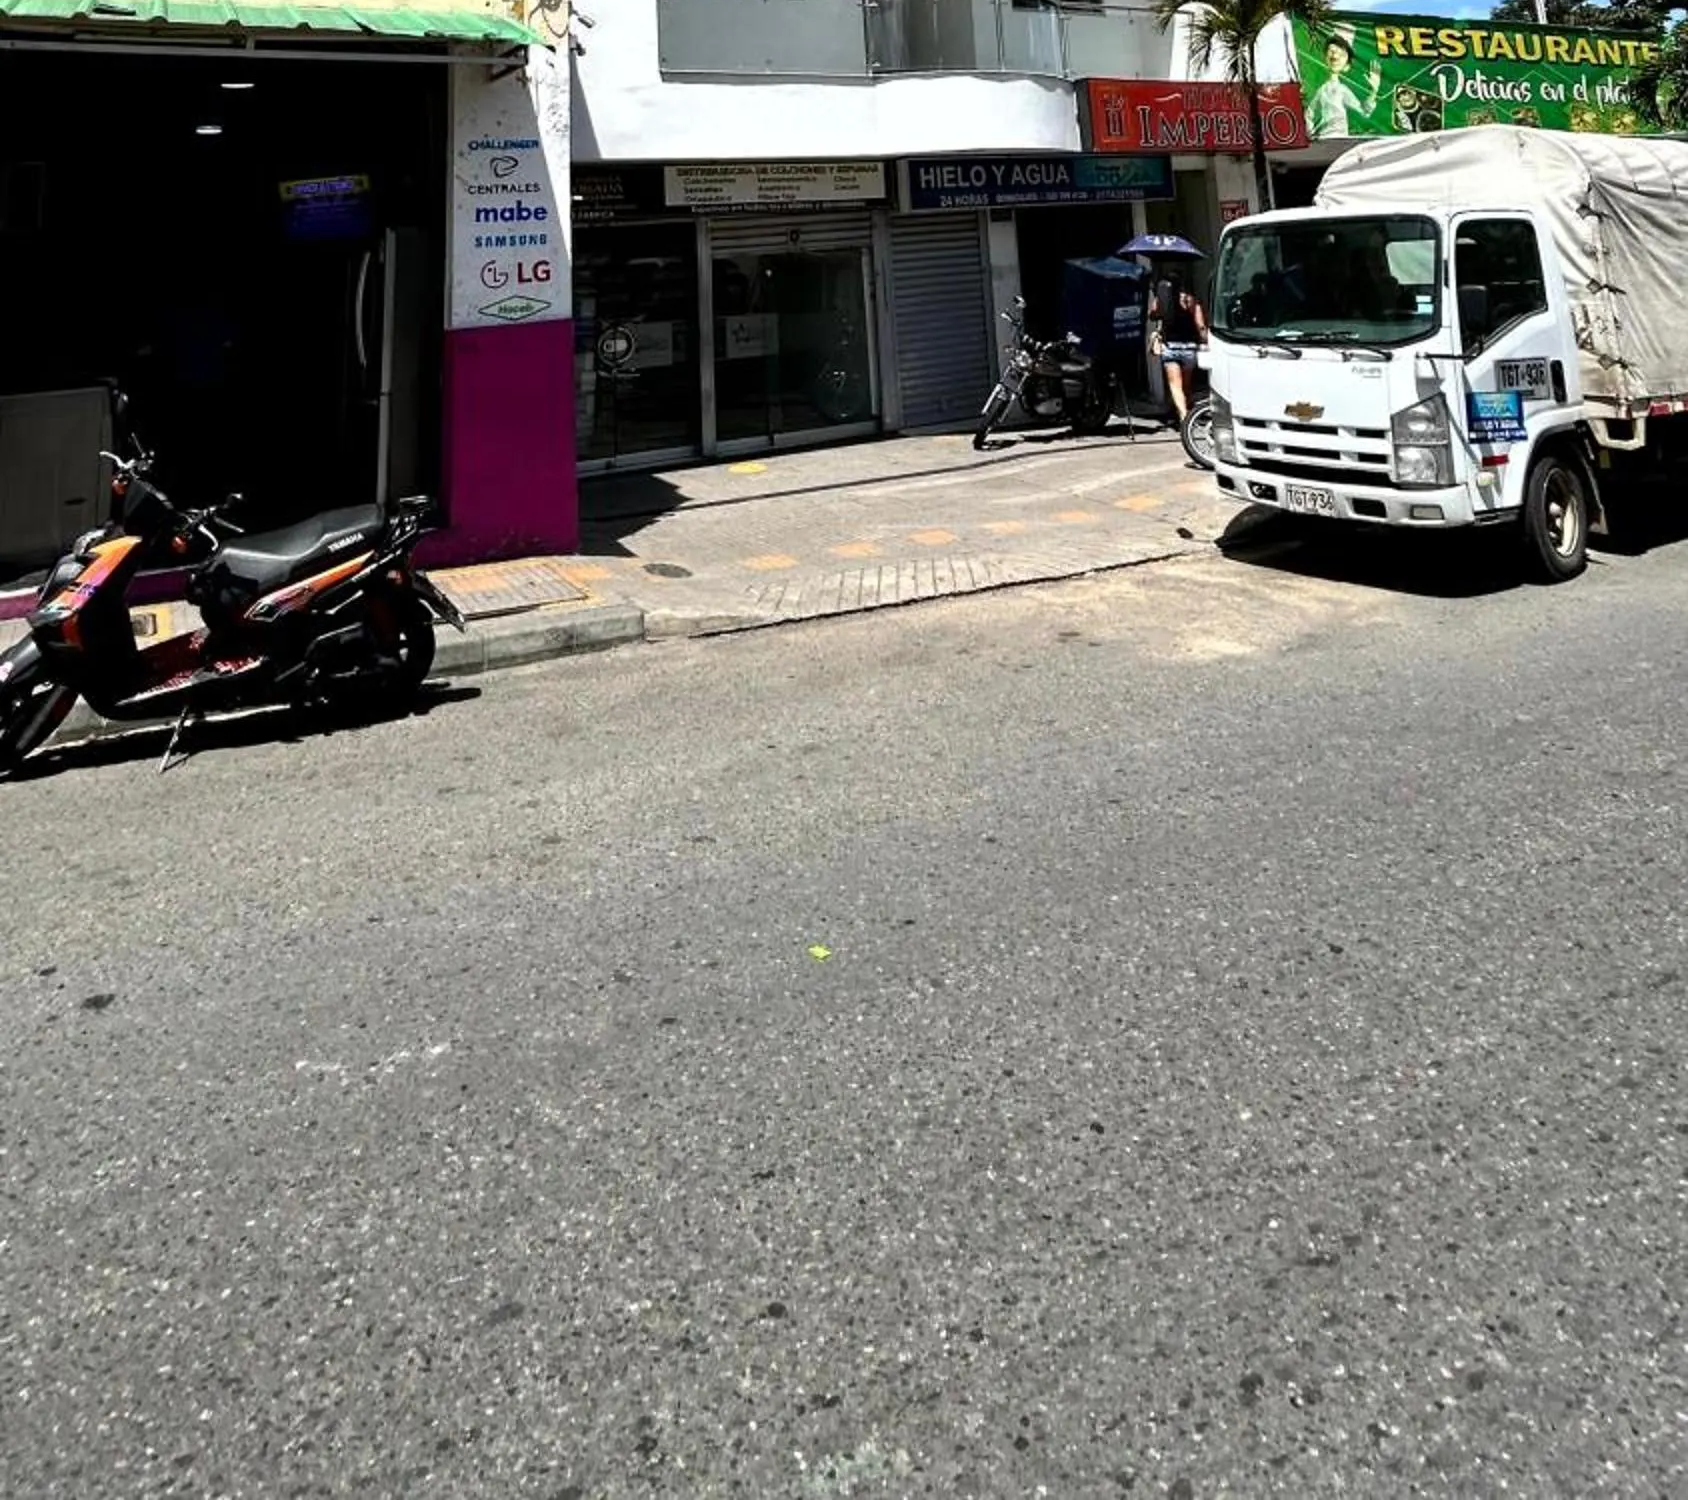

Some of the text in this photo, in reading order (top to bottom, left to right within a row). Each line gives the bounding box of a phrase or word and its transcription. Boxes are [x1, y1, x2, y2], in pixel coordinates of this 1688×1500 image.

[1374, 25, 1659, 66] RESTAURANTE
[1430, 62, 1532, 102] Delicias
[1540, 81, 1565, 102] en
[919, 164, 987, 189] HIELO
[991, 165, 1006, 187] Y
[1011, 163, 1071, 186] AGUA
[467, 183, 541, 195] CENTRALES
[475, 200, 548, 223] mabe
[474, 233, 547, 248] SAMSUNG
[517, 260, 551, 285] LG
